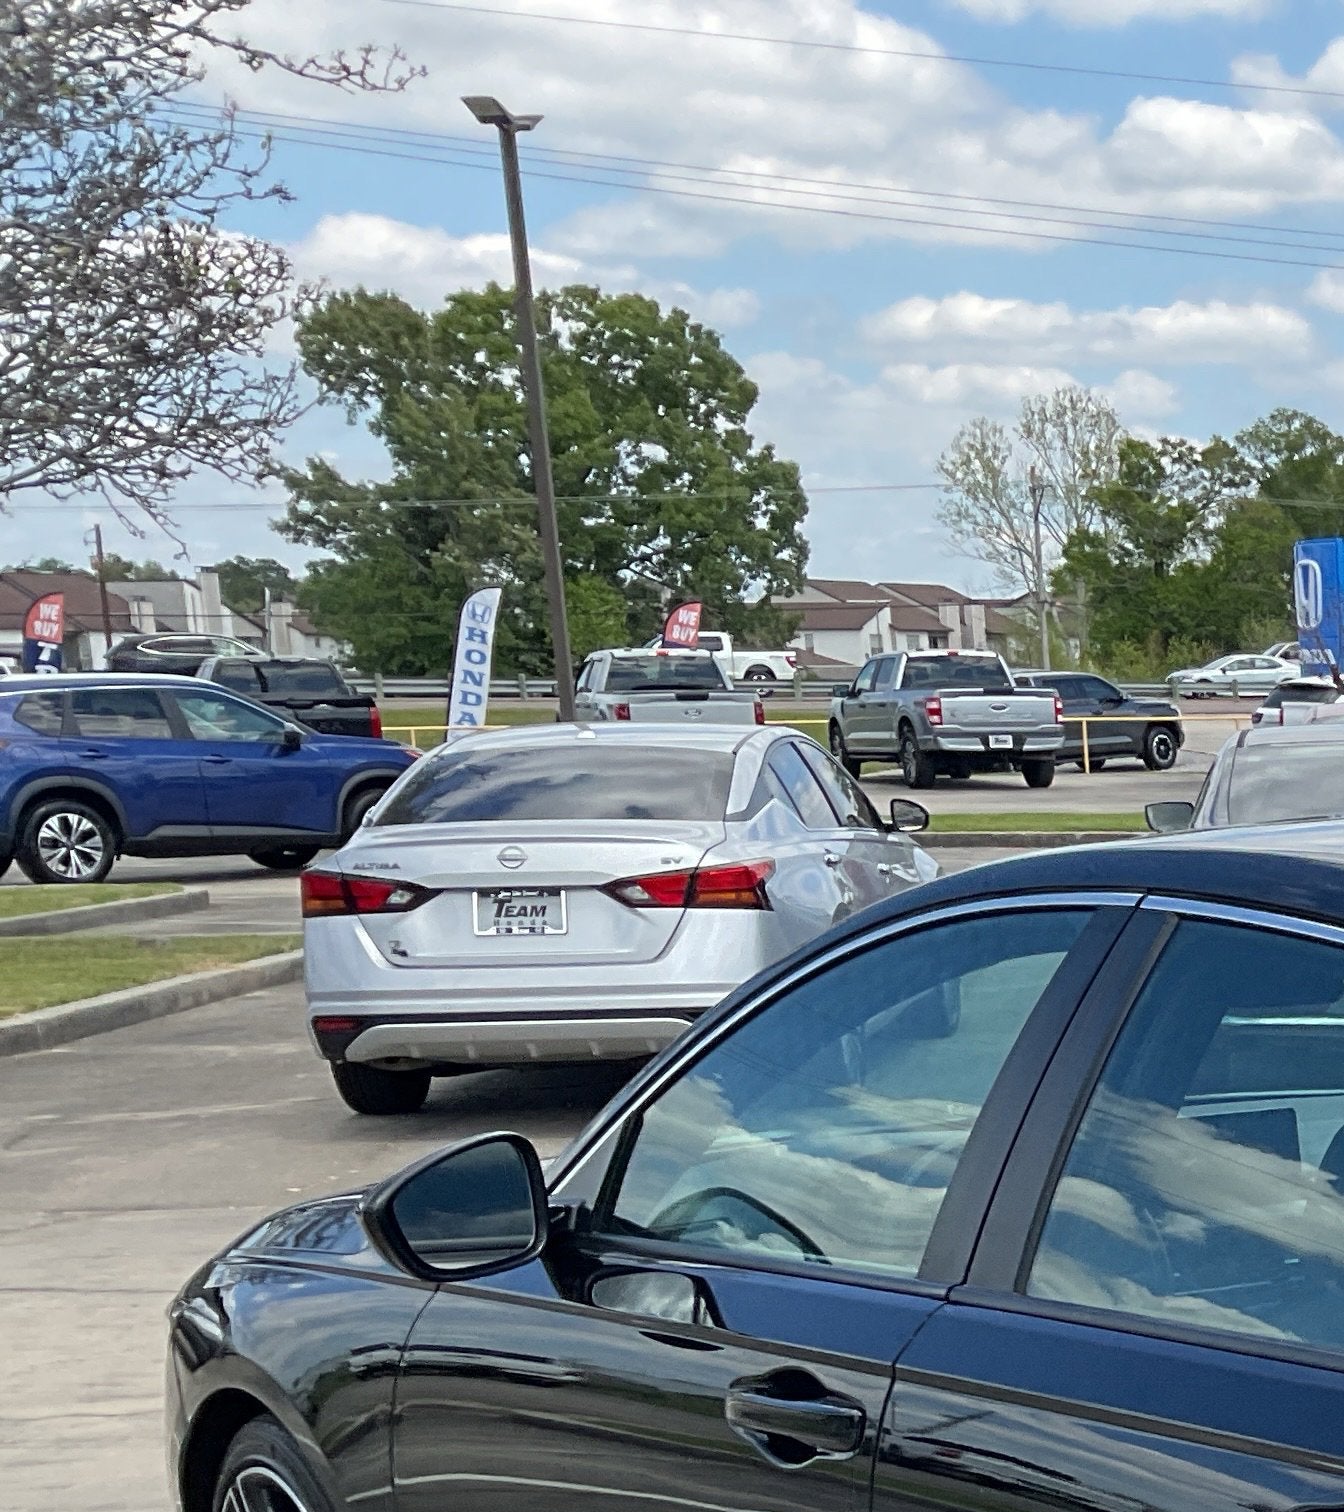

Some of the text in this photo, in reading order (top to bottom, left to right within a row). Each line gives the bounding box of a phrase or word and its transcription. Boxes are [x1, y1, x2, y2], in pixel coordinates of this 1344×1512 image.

[39, 603, 60, 621] WE
[678, 609, 698, 626] WE
[33, 619, 60, 638] BUY
[672, 624, 697, 643] BUY
[454, 626, 489, 727] HONDA
[492, 896, 547, 918] TEAM
